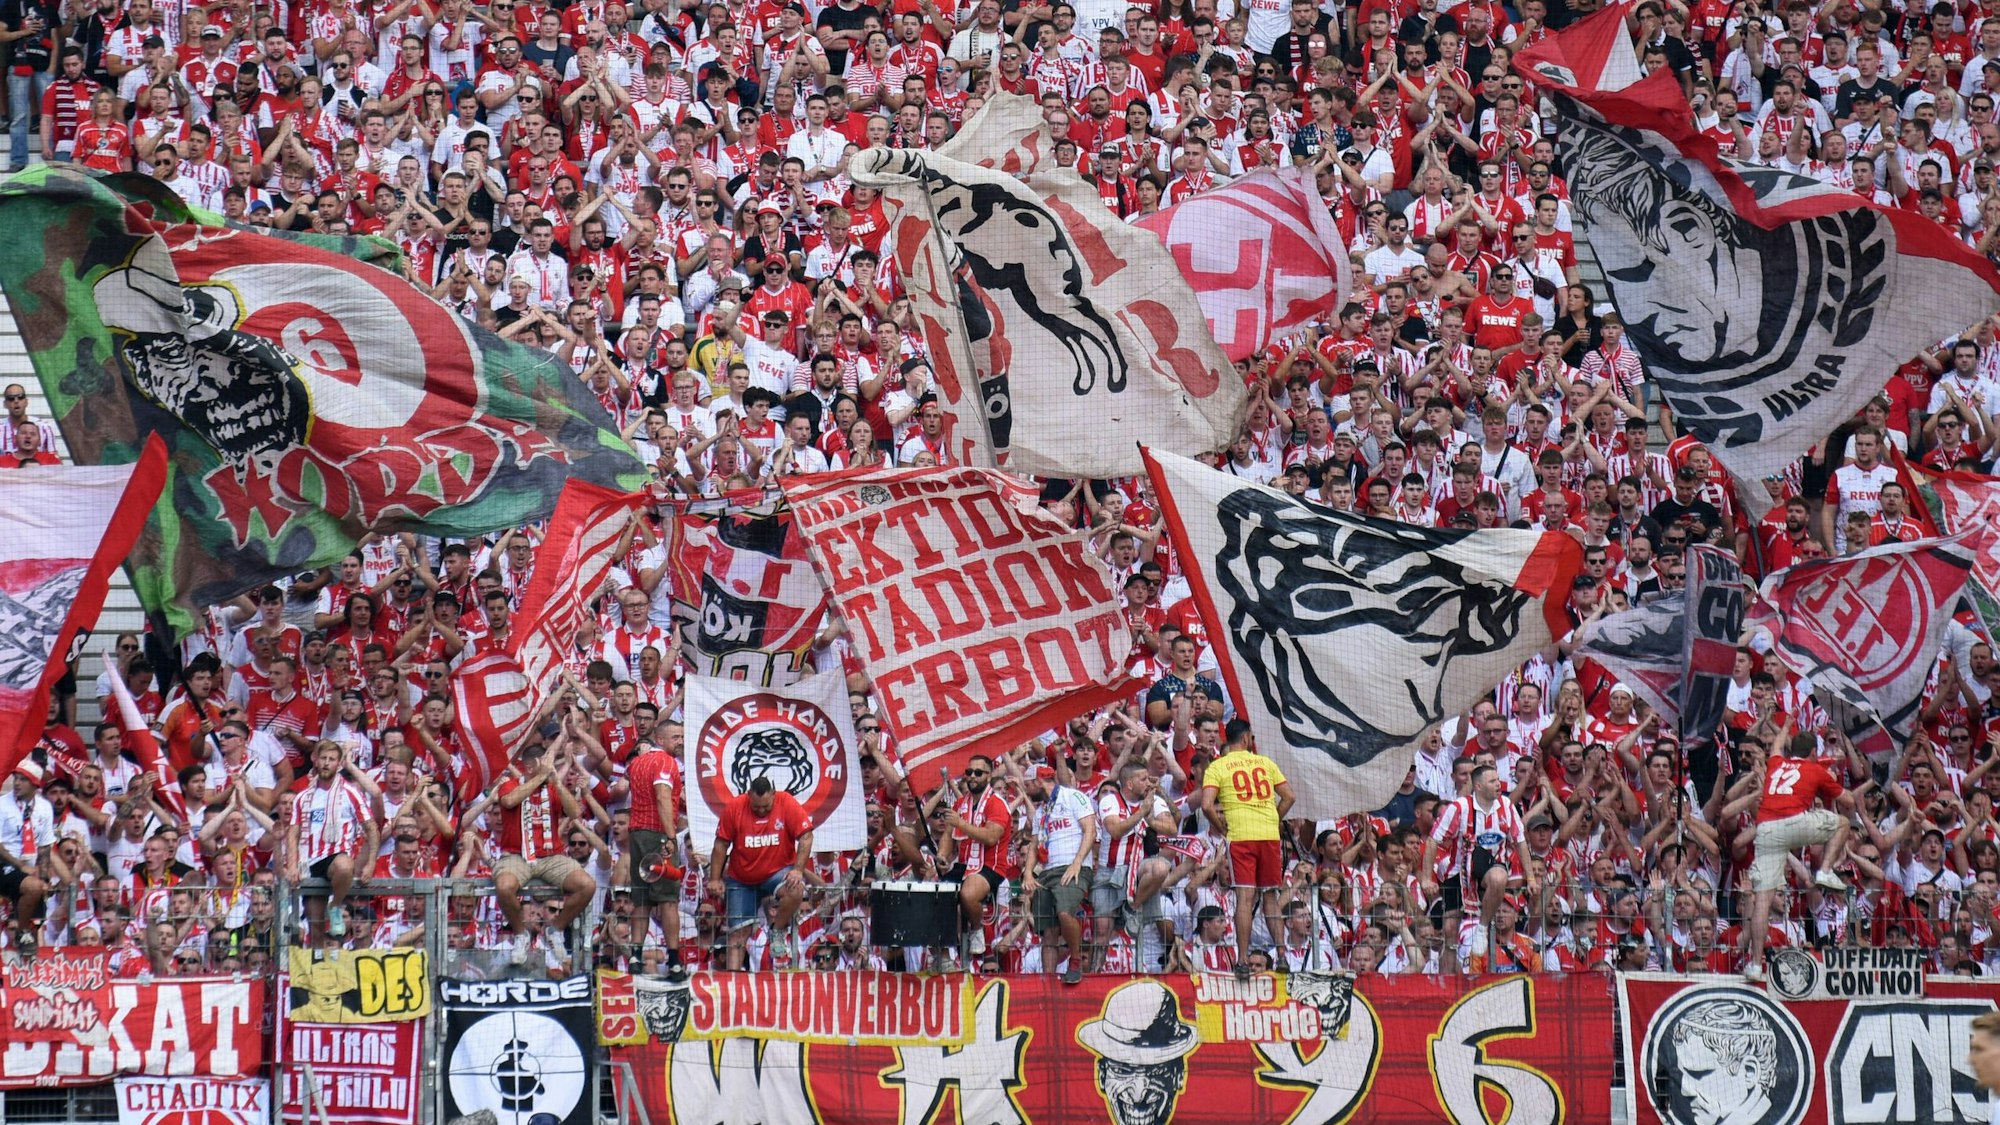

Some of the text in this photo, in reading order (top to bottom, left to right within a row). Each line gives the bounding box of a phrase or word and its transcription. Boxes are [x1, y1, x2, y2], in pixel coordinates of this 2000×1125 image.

[154, 1, 178, 9] EWE
[1129, 2, 1152, 13] EWE
[1251, 0, 1280, 10] REWE
[524, 22, 539, 31] VP
[766, 17, 781, 28] RE
[1092, 18, 1110, 27] VPV
[389, 37, 403, 45] RE
[127, 47, 142, 57] RE
[770, 51, 792, 61] REW
[1821, 85, 1838, 95] REW
[453, 144, 467, 153] RE
[1306, 144, 1321, 154] RE
[733, 164, 748, 174] RE
[850, 222, 876, 237] EWE
[1482, 315, 1517, 328] REWE
[283, 316, 345, 372] 6
[1903, 374, 1923, 386] VPV
[1762, 353, 1847, 423] ULTRA
[1157, 545, 1169, 554] RE
[846, 540, 1116, 662] TADION
[876, 610, 1122, 734] ERBOT
[367, 729, 381, 740] RE
[702, 701, 842, 780] WILDE HORDE
[1232, 767, 1271, 802] 96
[1769, 770, 1800, 793] 12
[1047, 818, 1071, 832] EWE
[744, 834, 780, 849] REWE
[1478, 833, 1502, 846] Ford
[387, 898, 405, 911] RE
[356, 953, 424, 1016] DES
[1196, 973, 1273, 1005] Junge
[440, 978, 589, 1006] HORDE
[601, 971, 967, 1040] SEK STADIONVERBOT
[1225, 1002, 1319, 1041] Horde
[292, 1029, 397, 1066] ULTRAS
[126, 1082, 262, 1112] CHAOTIX
